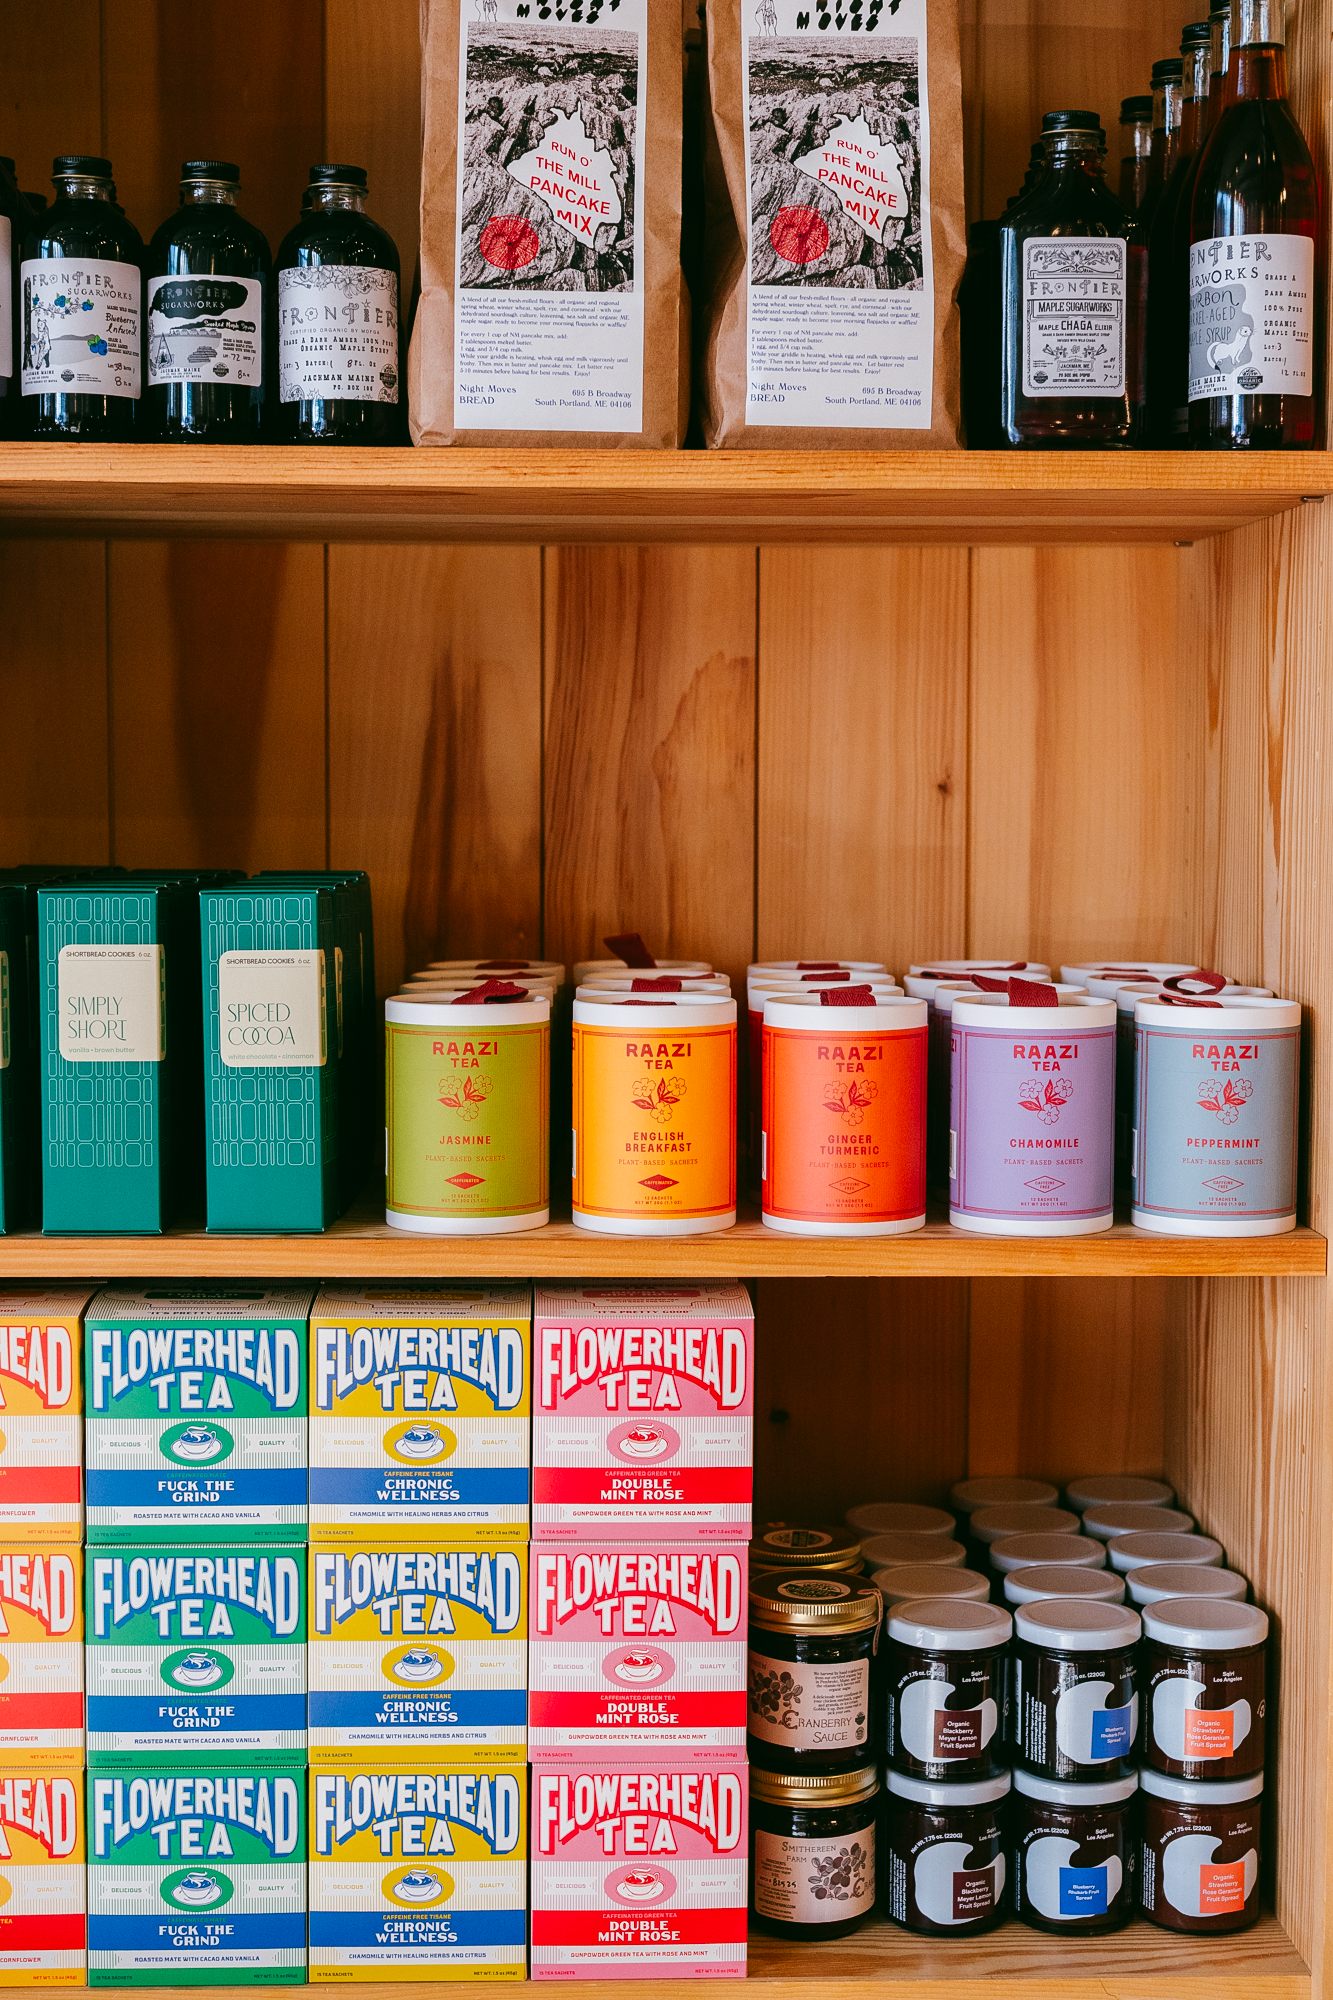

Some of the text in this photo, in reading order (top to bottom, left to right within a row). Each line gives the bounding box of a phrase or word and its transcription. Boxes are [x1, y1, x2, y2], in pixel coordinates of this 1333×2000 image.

[552, 142, 593, 167] RUN O'
[837, 140, 879, 160] RUN O'
[536, 157, 602, 191] THE MILL
[823, 153, 889, 183] THE MILL
[818, 169, 898, 208] PANCAKE
[530, 176, 611, 215] PANCAKE
[846, 201, 881, 231] MIX
[557, 210, 593, 237] MIX
[32, 271, 114, 290] FRONTIER
[68, 288, 132, 300] SUGARWORKS
[161, 285, 231, 300] FRONTIER
[1030, 280, 1121, 296] FRONTIER
[161, 301, 225, 310] SUGARWORKS
[1039, 302, 1112, 313] MAPLE SUGARWORKS
[282, 299, 396, 329] FRONTIER
[1061, 321, 1093, 331] CHAGA
[1206, 326, 1232, 344] SYRUP
[303, 374, 342, 382] JACKMAN
[460, 385, 517, 393] Night Moves
[752, 383, 807, 391] Night Moves
[460, 396, 495, 405] BREAD
[597, 391, 632, 399] Broadway
[751, 394, 785, 403] BREAD
[560, 399, 591, 408] Portland,
[68, 997, 123, 1015] SIMPLY
[228, 1003, 290, 1022] SPICED
[68, 1020, 127, 1041] SHORT
[228, 1026, 295, 1046] COCOA
[433, 1042, 498, 1056] RAAZI
[626, 1043, 691, 1057] RAAZI
[818, 1046, 883, 1061] RAAZI
[1014, 1045, 1078, 1059] RAAZI
[1193, 1045, 1259, 1059] RAAZI
[451, 1058, 480, 1068] TEA
[645, 1060, 673, 1070] TEA
[836, 1063, 865, 1073] TEA
[1032, 1062, 1061, 1071] TEA
[1211, 1061, 1240, 1071] TEA
[440, 1136, 491, 1145] JASMINE
[633, 1132, 684, 1141] ENGLISH
[828, 1135, 872, 1144] GINGER
[626, 1143, 692, 1152] BREAKFAST
[1010, 1139, 1079, 1148] CHAMOMILE
[1187, 1138, 1260, 1148] PEPPERMINT
[820, 1146, 879, 1155] TURMERIC
[91, 1329, 300, 1412] FLOWERHEAD
[316, 1327, 523, 1410] FLOWERHEAD
[541, 1327, 747, 1410] FLOWERHEAD
[149, 1371, 235, 1413] TEA
[374, 1370, 458, 1411] TEA
[599, 1369, 682, 1411] TEA
[158, 1480, 235, 1492] FUCK THE
[384, 1479, 453, 1490] CHRONIC
[612, 1479, 672, 1490] DOUBLE
[172, 1492, 220, 1502] GRIND
[376, 1490, 460, 1501] WELLNESS
[601, 1489, 684, 1500] MINT ROSE
[93, 1557, 300, 1639] FLOWERHEAD
[315, 1553, 521, 1635] FLOWERHEAD
[537, 1553, 741, 1636] FLOWERHEAD
[150, 1598, 235, 1640] TEA
[372, 1594, 456, 1635] TEA
[593, 1595, 677, 1636] TEA
[159, 1706, 235, 1717] FUCK THE
[383, 1701, 450, 1712] CHRONIC
[608, 1703, 667, 1713] DOUBLE
[173, 1718, 220, 1728] GRIND
[375, 1713, 459, 1723] WELLNESS
[596, 1714, 679, 1724] MINT ROSE
[782, 1710, 852, 1730] CRANBERRY
[813, 1732, 848, 1743] SAUCE
[93, 1777, 300, 1859] FLOWERHEAD
[316, 1774, 520, 1856] FLOWERHEAD
[538, 1773, 742, 1855] FLOWERHEAD
[150, 1819, 234, 1859] TEA
[372, 1816, 455, 1856] TEA
[595, 1814, 678, 1855] TEA
[782, 1842, 837, 1853] SMITHEREEN
[159, 1925, 235, 1936] FUCK THE
[384, 1922, 450, 1932] CHRONIC
[609, 1921, 669, 1931] DOUBLE
[173, 1936, 220, 1946] GRIND
[376, 1933, 458, 1943] WELLNESS
[598, 1931, 681, 1942] MINT ROSE
